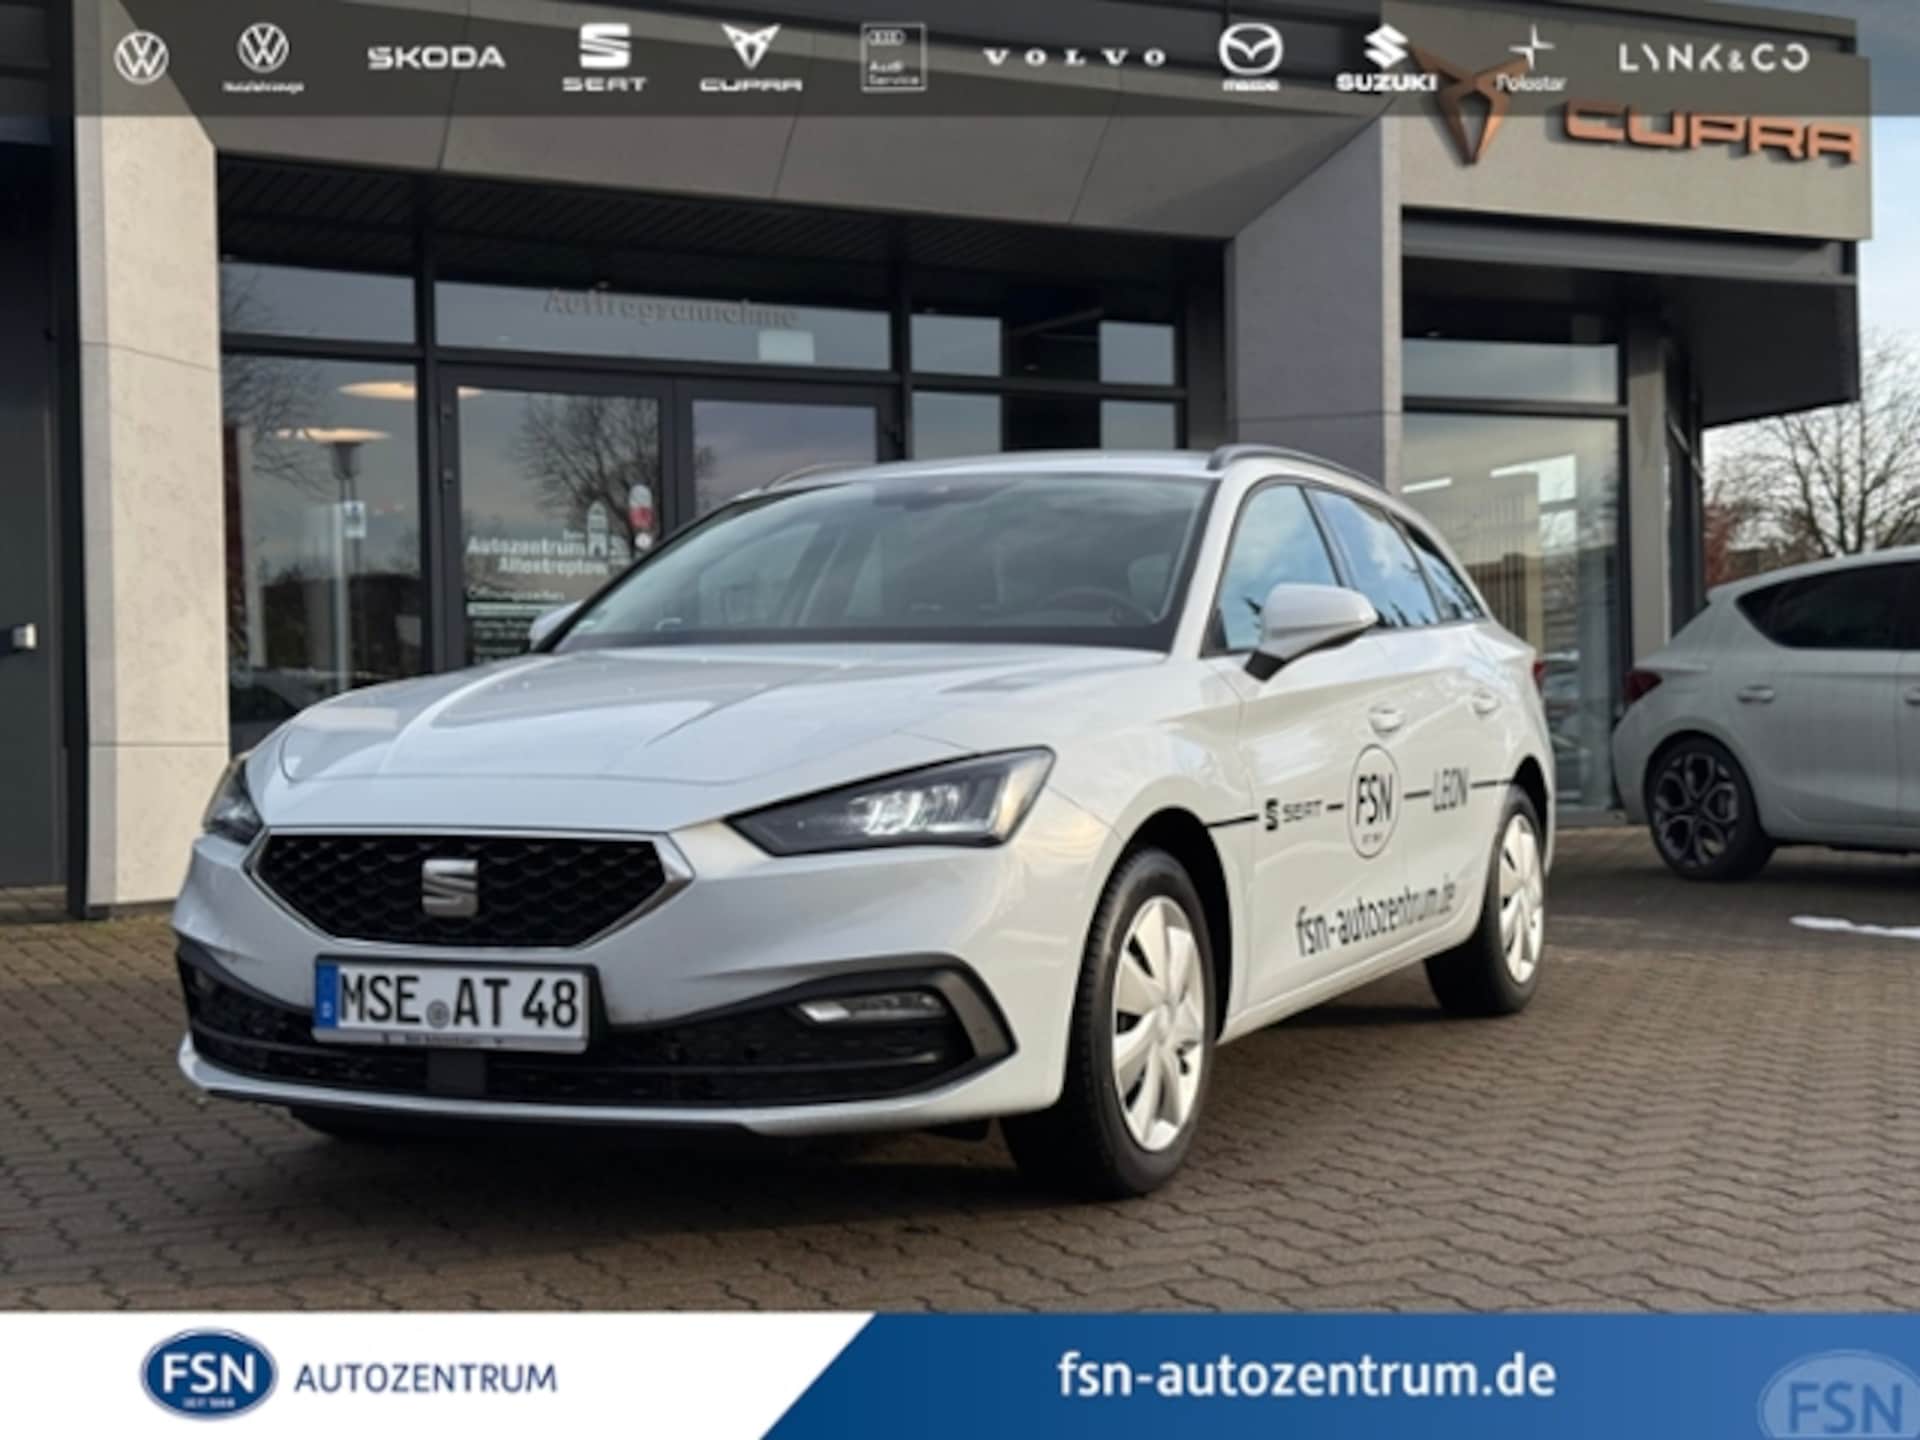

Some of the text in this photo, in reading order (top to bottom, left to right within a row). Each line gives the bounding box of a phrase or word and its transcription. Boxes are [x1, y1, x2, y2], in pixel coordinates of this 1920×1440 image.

[1563, 101, 1862, 164] CUPRA
[1355, 773, 1394, 825] FSN
[1433, 768, 1470, 812] LEON
[1296, 873, 1456, 957] fsn-autozentrum.de
[340, 974, 579, 1029] MSE AT 48
